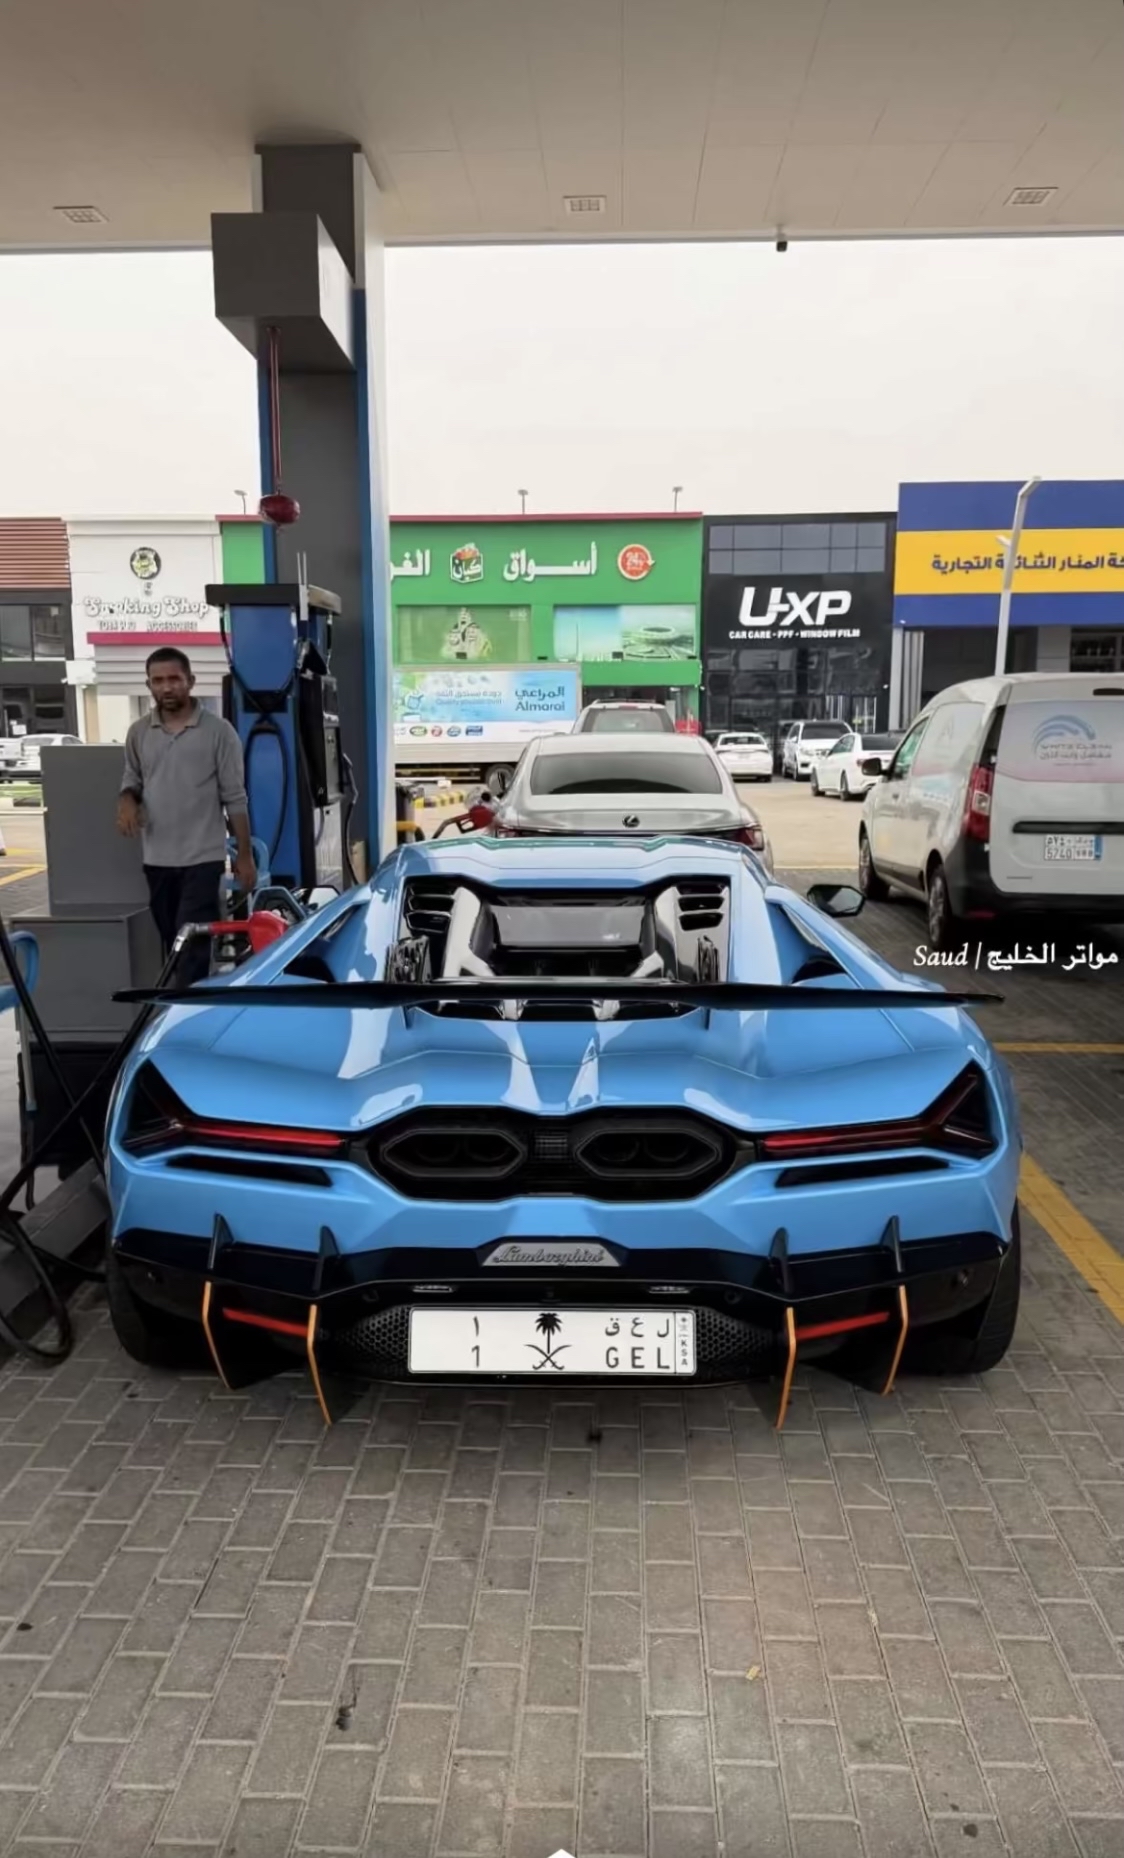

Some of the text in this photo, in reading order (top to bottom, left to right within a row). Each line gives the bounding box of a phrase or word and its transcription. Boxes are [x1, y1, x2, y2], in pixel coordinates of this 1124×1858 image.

[503, 541, 597, 581] أسواق
[932, 554, 992, 575] التجارية
[1059, 554, 1104, 571] المنار
[163, 597, 209, 618] Shop
[729, 628, 860, 639] CAR CARE PPF WINDOW FILM
[515, 686, 565, 701] المراعي
[515, 701, 565, 711] Almarai
[493, 1246, 604, 1267] Lamborghini
[471, 1345, 480, 1367] 1
